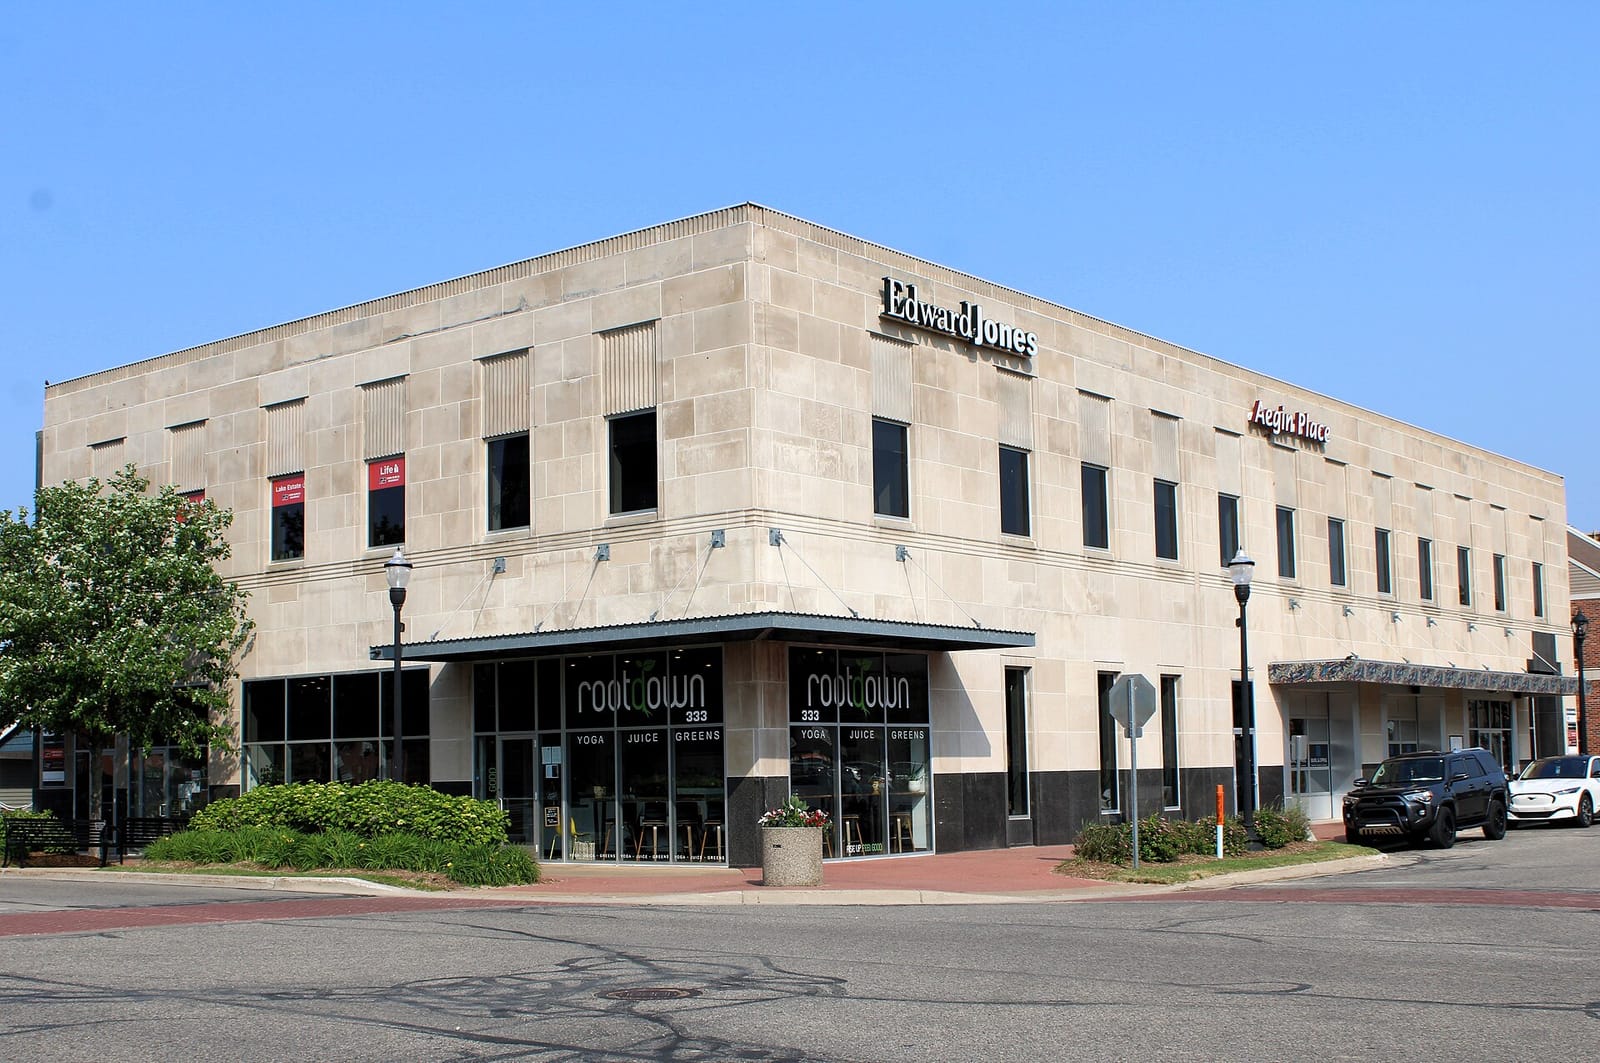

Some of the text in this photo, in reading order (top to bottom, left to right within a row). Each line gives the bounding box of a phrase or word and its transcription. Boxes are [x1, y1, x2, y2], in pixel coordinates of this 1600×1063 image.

[880, 276, 1039, 357] Edward Jones
[1250, 399, 1331, 442] Aegin Place
[380, 464, 394, 475] Life
[578, 667, 705, 718] rootdown
[807, 666, 910, 717] rootdown
[685, 710, 708, 722] 333
[801, 709, 820, 721] 333
[576, 730, 721, 745] YOGA JUICE GREENS
[801, 729, 925, 740] YOGA JUICE GREENS
